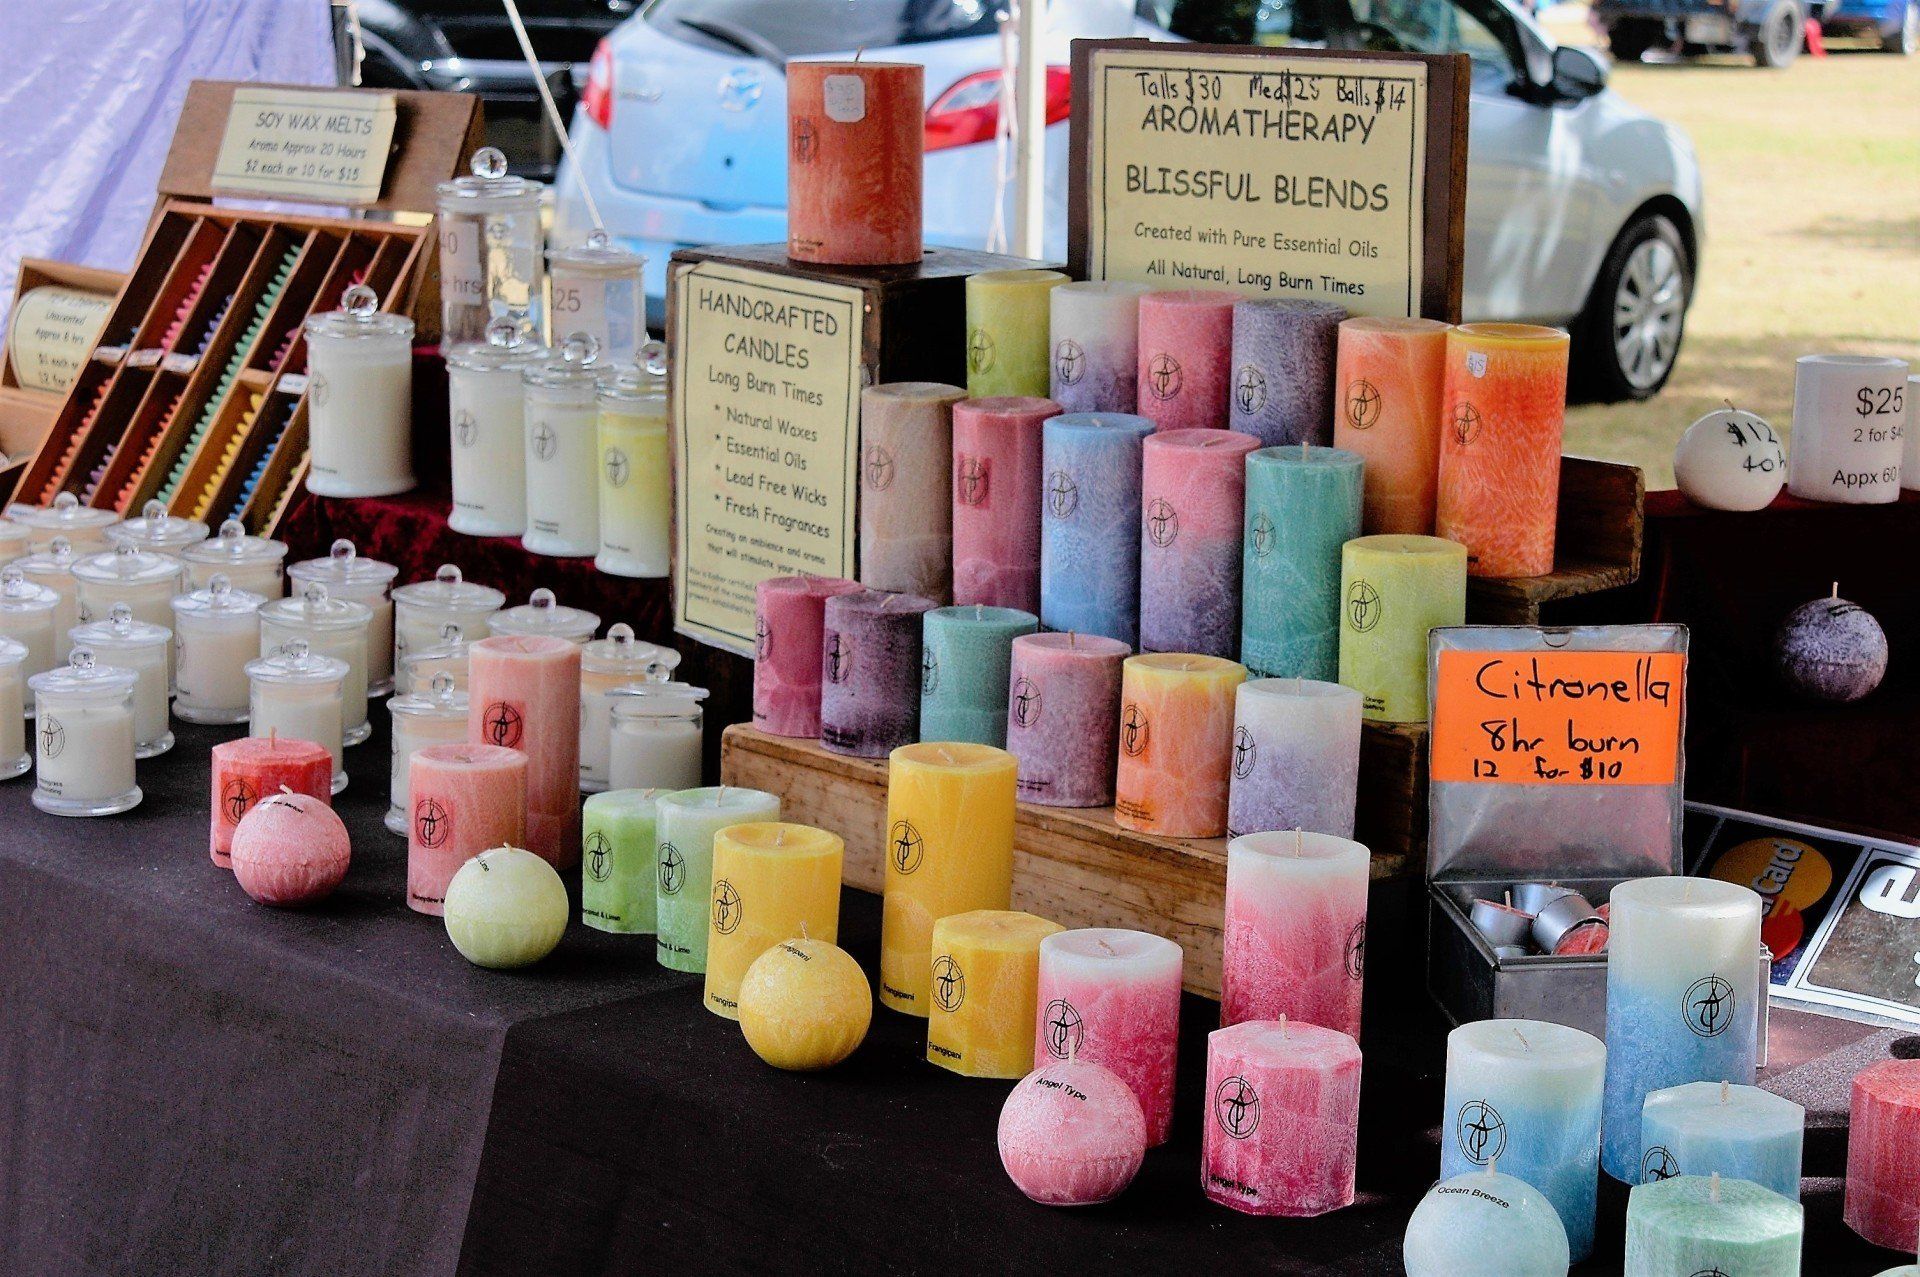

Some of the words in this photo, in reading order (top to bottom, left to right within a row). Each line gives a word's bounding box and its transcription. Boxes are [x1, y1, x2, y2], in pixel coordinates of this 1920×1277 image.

[1135, 72, 1178, 99] Talls
[1337, 76, 1370, 106] Balls
[1375, 79, 1405, 113] $14
[255, 112, 283, 128] SOY
[289, 114, 321, 131] WAX
[326, 116, 373, 135] MELTS
[1142, 104, 1375, 145] AROMATHERAPY
[249, 138, 278, 151] Aroma
[283, 139, 317, 157] Approx
[320, 142, 333, 155] 20
[338, 144, 366, 159] Hours
[245, 159, 259, 172] $2
[262, 162, 283, 175] each
[287, 166, 297, 175] or
[302, 164, 314, 176] 10
[319, 166, 333, 177] for
[339, 168, 360, 181] $15
[1126, 164, 1260, 202] BLISSFUL
[1274, 174, 1389, 212] BLENDS
[1134, 222, 1192, 242] Created
[1198, 228, 1227, 245] with
[1234, 229, 1266, 249] Pure
[1273, 233, 1341, 256] Essential
[1349, 240, 1378, 259] Oils
[453, 275, 481, 294] hrs
[1147, 260, 1165, 276] All
[1172, 262, 1230, 285] Natural,
[1238, 268, 1271, 291] Long
[1280, 271, 1313, 291] Burn
[1320, 275, 1365, 296] Times
[700, 288, 838, 336] HANDCRAFTED
[725, 333, 809, 369] CANDLES
[709, 365, 740, 392] Long
[747, 372, 776, 396] Burn
[782, 380, 823, 405] Times
[1856, 386, 1903, 418] $25
[726, 407, 772, 430] Natural
[778, 419, 818, 442] Waxes
[1853, 428, 1863, 442] 2
[1869, 427, 1887, 442] for
[726, 436, 779, 463] Essential
[785, 451, 807, 471] Oils
[726, 467, 754, 487] Lead
[759, 475, 787, 496] Free
[792, 484, 827, 507] Wicks
[1832, 469, 1877, 488] Appx
[706, 524, 736, 542] Creating
[726, 497, 759, 520] Fresh
[764, 507, 830, 538] Fragrances
[1476, 656, 1670, 707] Citronella
[1569, 718, 1639, 753] burn
[1474, 758, 1499, 778] 12
[1535, 756, 1569, 779] for
[1580, 756, 1622, 779] $10
[711, 992, 738, 1008] Frangipa
[928, 1041, 962, 1060] Frangipani
[1036, 1077, 1062, 1089] Angel
[1064, 1084, 1087, 1101] Type
[1437, 1186, 1470, 1195] Ocean
[1472, 1188, 1510, 1209] Breeze
